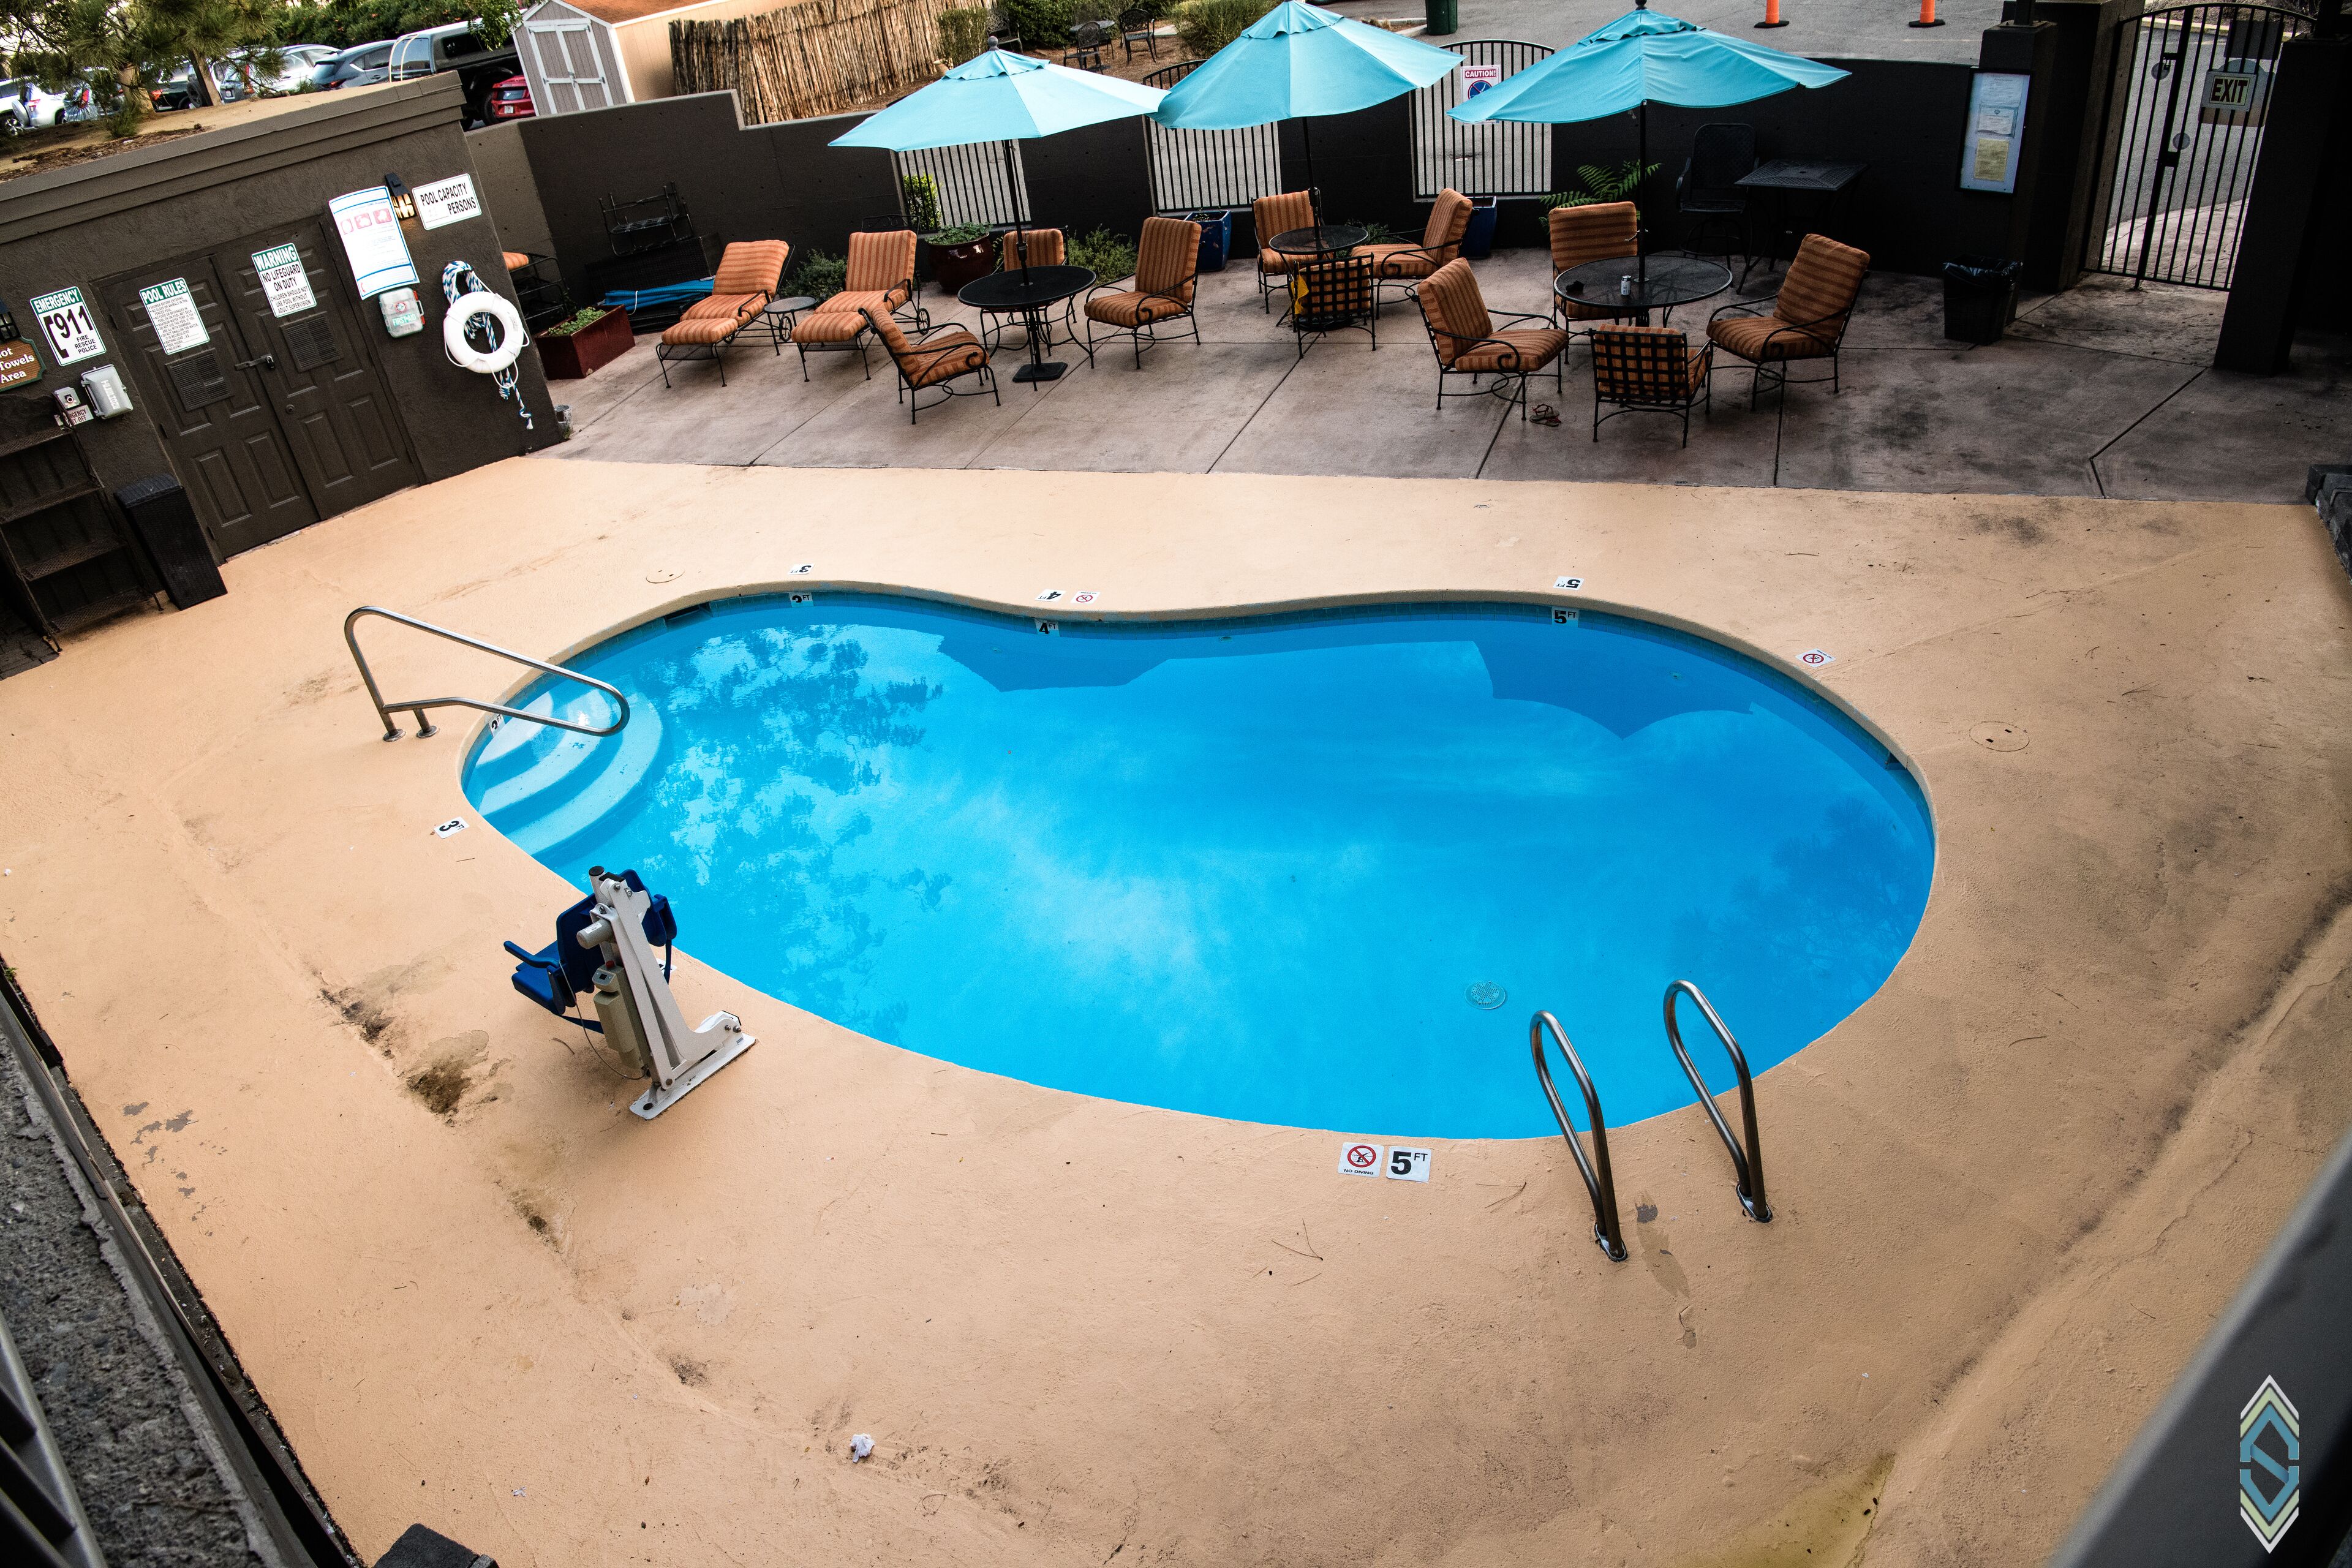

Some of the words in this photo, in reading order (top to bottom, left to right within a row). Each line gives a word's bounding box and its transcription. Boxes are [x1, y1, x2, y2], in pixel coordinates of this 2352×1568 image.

[2211, 78, 2248, 103] EXIT
[420, 192, 439, 206] POOL
[438, 183, 467, 201] CAPACITY
[447, 197, 477, 215] PERSONS
[254, 246, 297, 271] WARNING
[262, 272, 271, 282] NO
[271, 264, 301, 281] LIFEGUARD
[274, 282, 283, 291] ON
[282, 276, 297, 289] DUTY
[141, 288, 164, 304] POOL
[161, 281, 187, 298] RULES
[270, 293, 287, 301] CHILDREN
[287, 288, 301, 296] SHOULD
[292, 293, 307, 302] WITHOUT
[34, 289, 79, 313] EMERGENCY
[289, 300, 311, 310] SUPERVISION
[53, 305, 93, 338] 911
[75, 339, 96, 349] RESCUE
[78, 344, 97, 354] POLICE
[0, 347, 13, 358] ot
[1, 371, 26, 383] Area
[1566, 579, 1581, 588] 5
[1046, 591, 1061, 600] 4
[1554, 609, 1567, 624] 5
[1039, 622, 1050, 635] 4
[439, 821, 459, 832] 3
[1391, 1151, 1412, 1175] 5
[1414, 1153, 1428, 1162] FT
